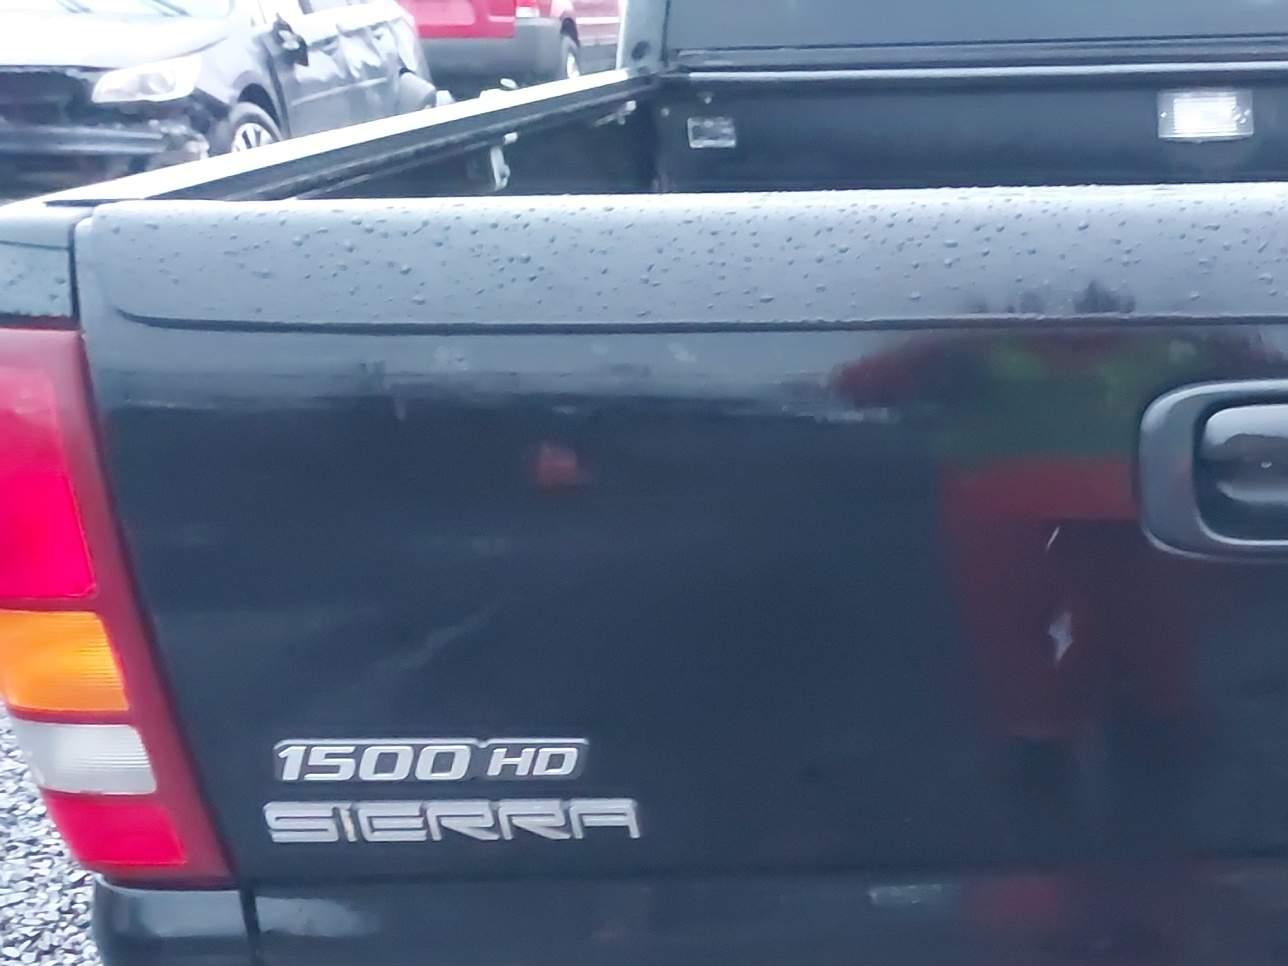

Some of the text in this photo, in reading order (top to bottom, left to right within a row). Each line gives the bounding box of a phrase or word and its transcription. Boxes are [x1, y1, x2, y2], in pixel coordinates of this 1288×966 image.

[276, 742, 580, 781] 1500 HD
[263, 798, 640, 843] SIERRA
